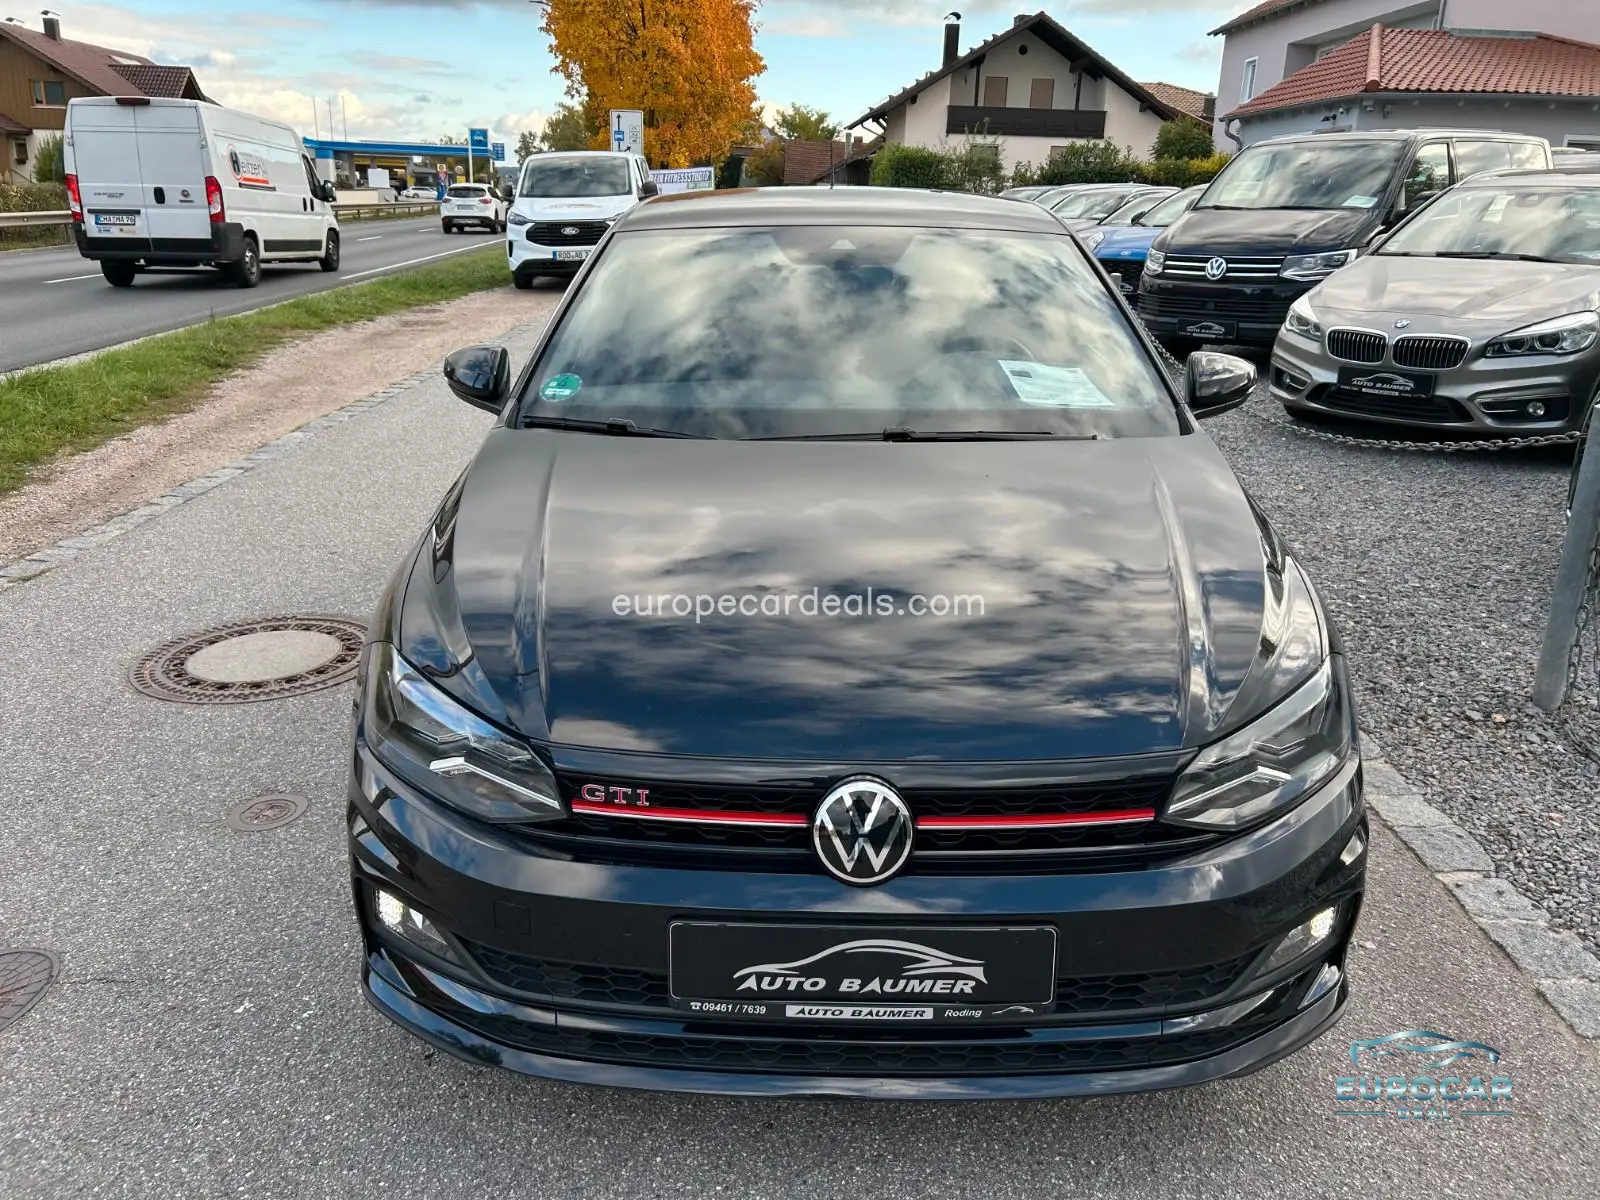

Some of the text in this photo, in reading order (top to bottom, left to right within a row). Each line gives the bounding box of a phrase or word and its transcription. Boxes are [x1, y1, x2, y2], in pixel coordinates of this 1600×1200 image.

[1375, 383, 1412, 391] BAUMER
[580, 783, 650, 807] GTI
[735, 974, 977, 995] AUTO BAUMER
[702, 1002, 733, 1012] 09461
[742, 1005, 767, 1014] 7639
[795, 1007, 927, 1018] AUTO BAUMER
[944, 1009, 983, 1018] Roding
